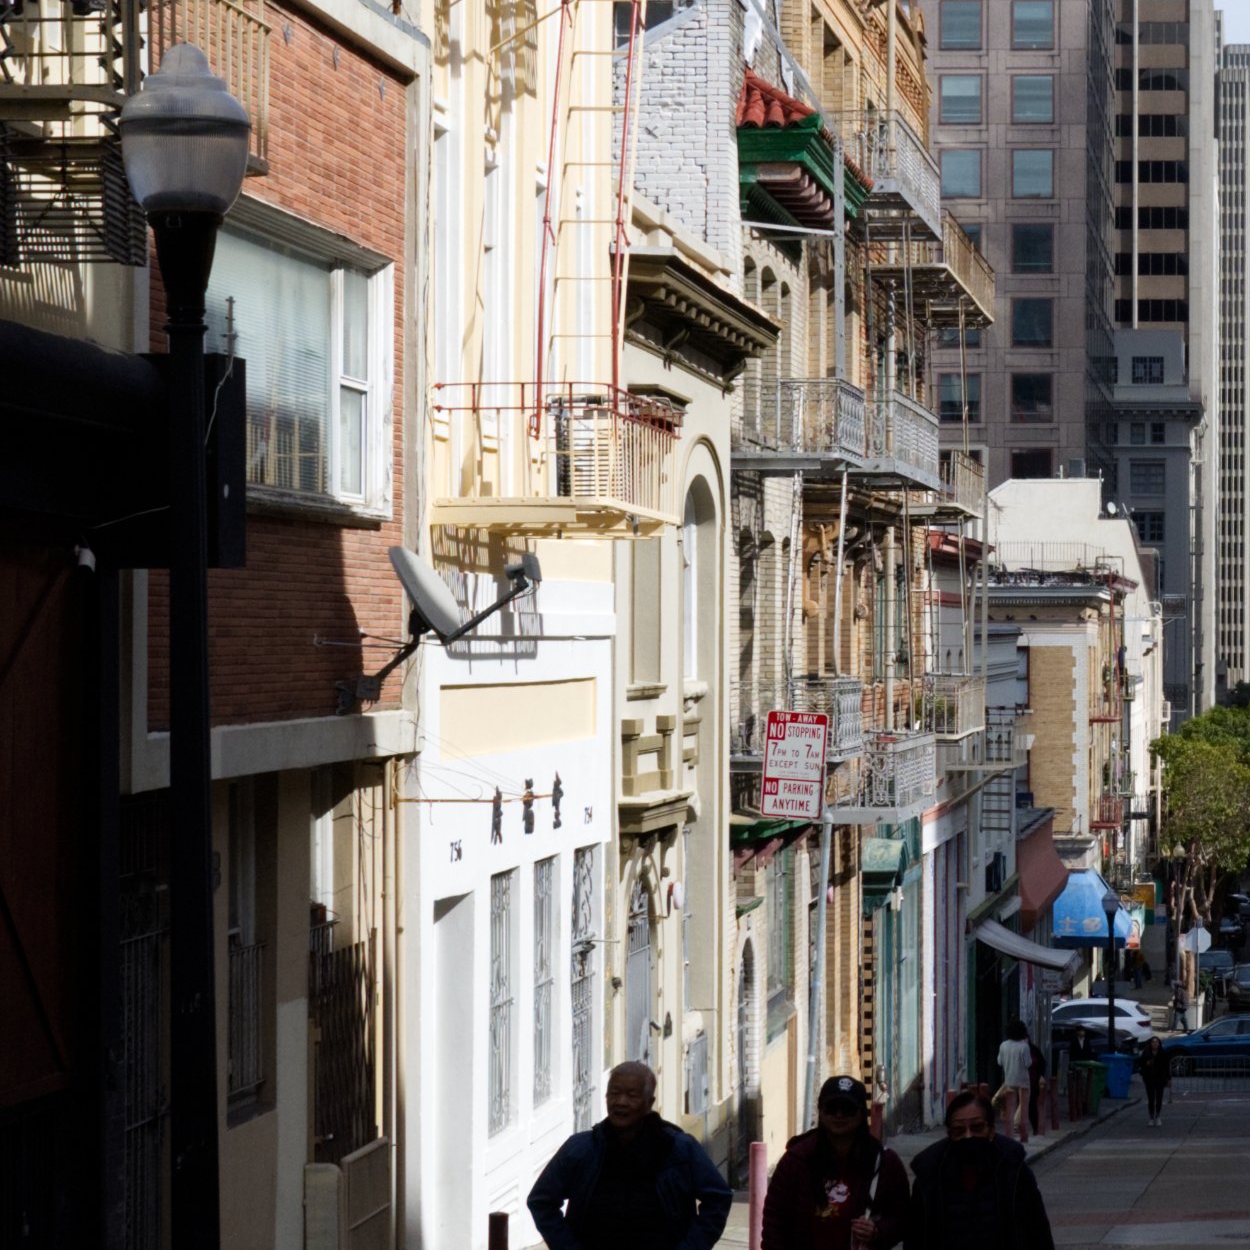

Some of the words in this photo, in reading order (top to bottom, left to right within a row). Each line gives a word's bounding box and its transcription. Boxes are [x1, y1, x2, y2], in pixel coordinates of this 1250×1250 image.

[776, 712, 792, 722] TOW
[797, 714, 818, 724] AWAY
[770, 723, 784, 738] NO
[787, 726, 821, 739] STOPPING
[791, 749, 800, 758] TO
[769, 759, 798, 769] EXCEPT
[804, 761, 821, 771] SUN
[765, 781, 777, 793] NO
[783, 782, 814, 796] PARKING
[772, 798, 811, 812] ANYTIME
[450, 839, 462, 862] 756
